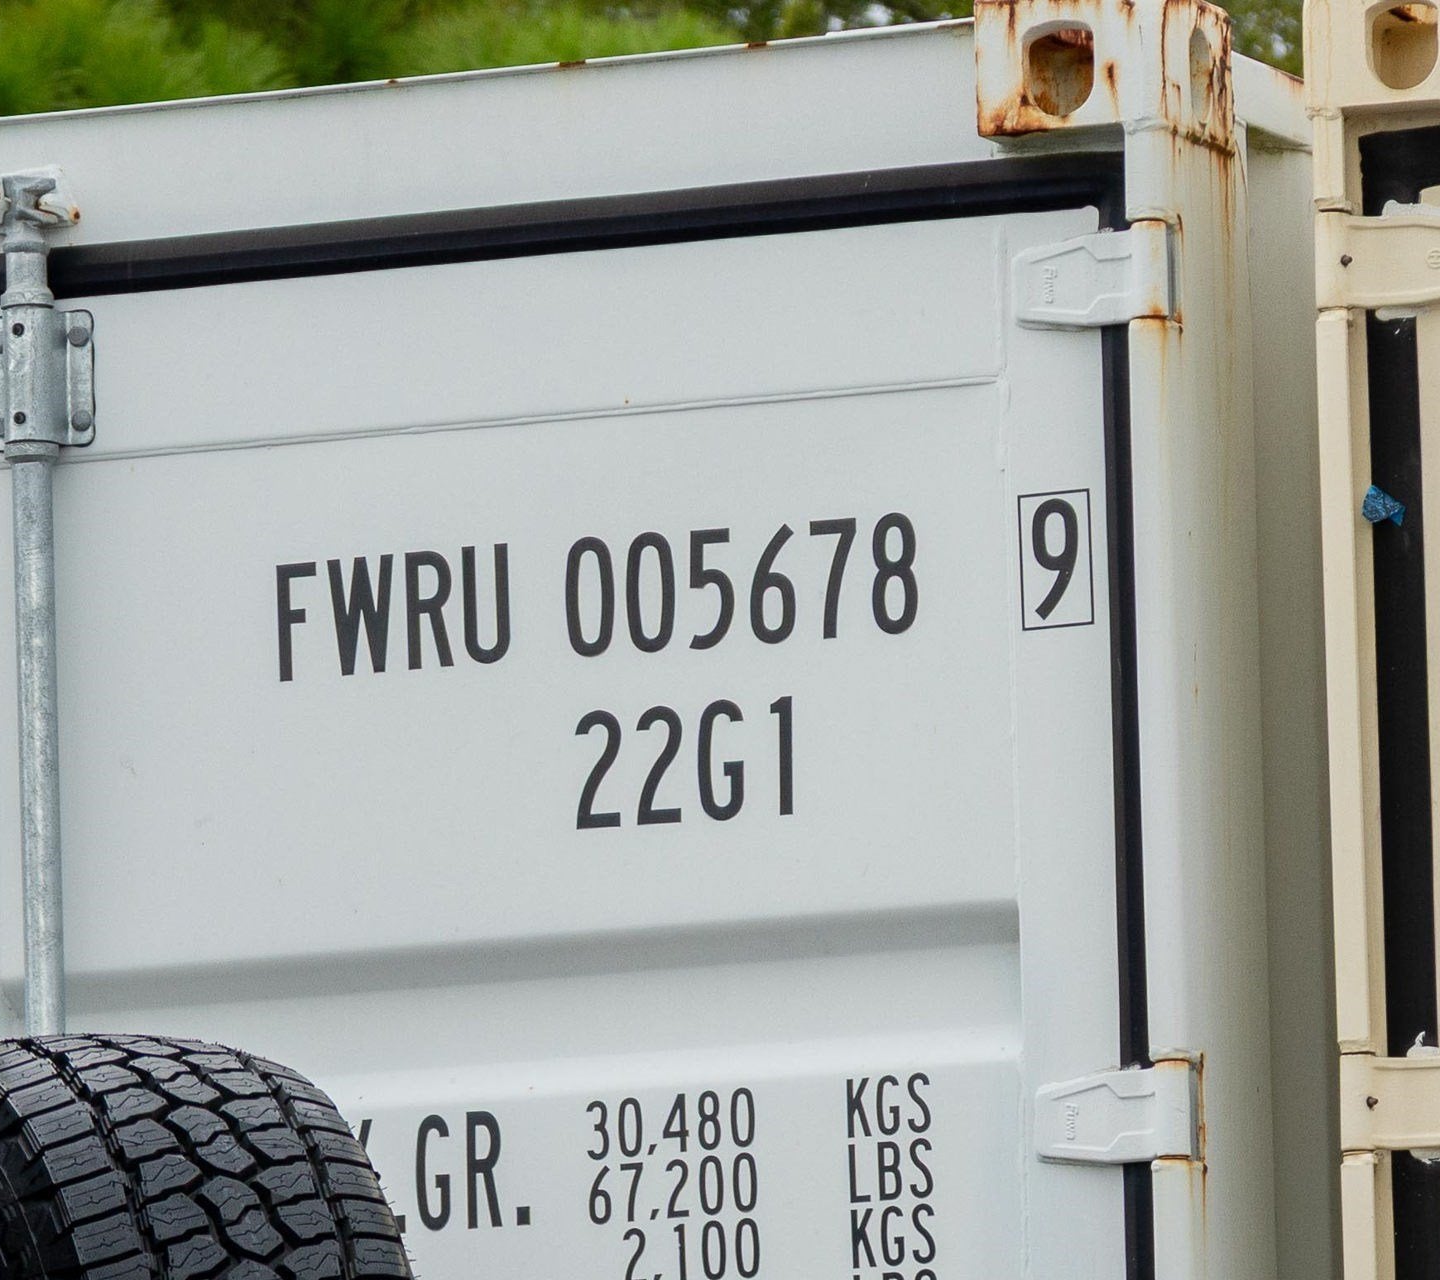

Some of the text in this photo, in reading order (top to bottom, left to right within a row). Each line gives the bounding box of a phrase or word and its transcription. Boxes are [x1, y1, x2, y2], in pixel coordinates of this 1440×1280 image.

[276, 499, 1078, 681] FWRU 005678 9
[575, 696, 793, 829] 22G1
[358, 1073, 930, 1232] .GR. 30,480 KGS
[588, 1138, 933, 1226] 67,200 LBS
[851, 1204, 935, 1272] KGS
